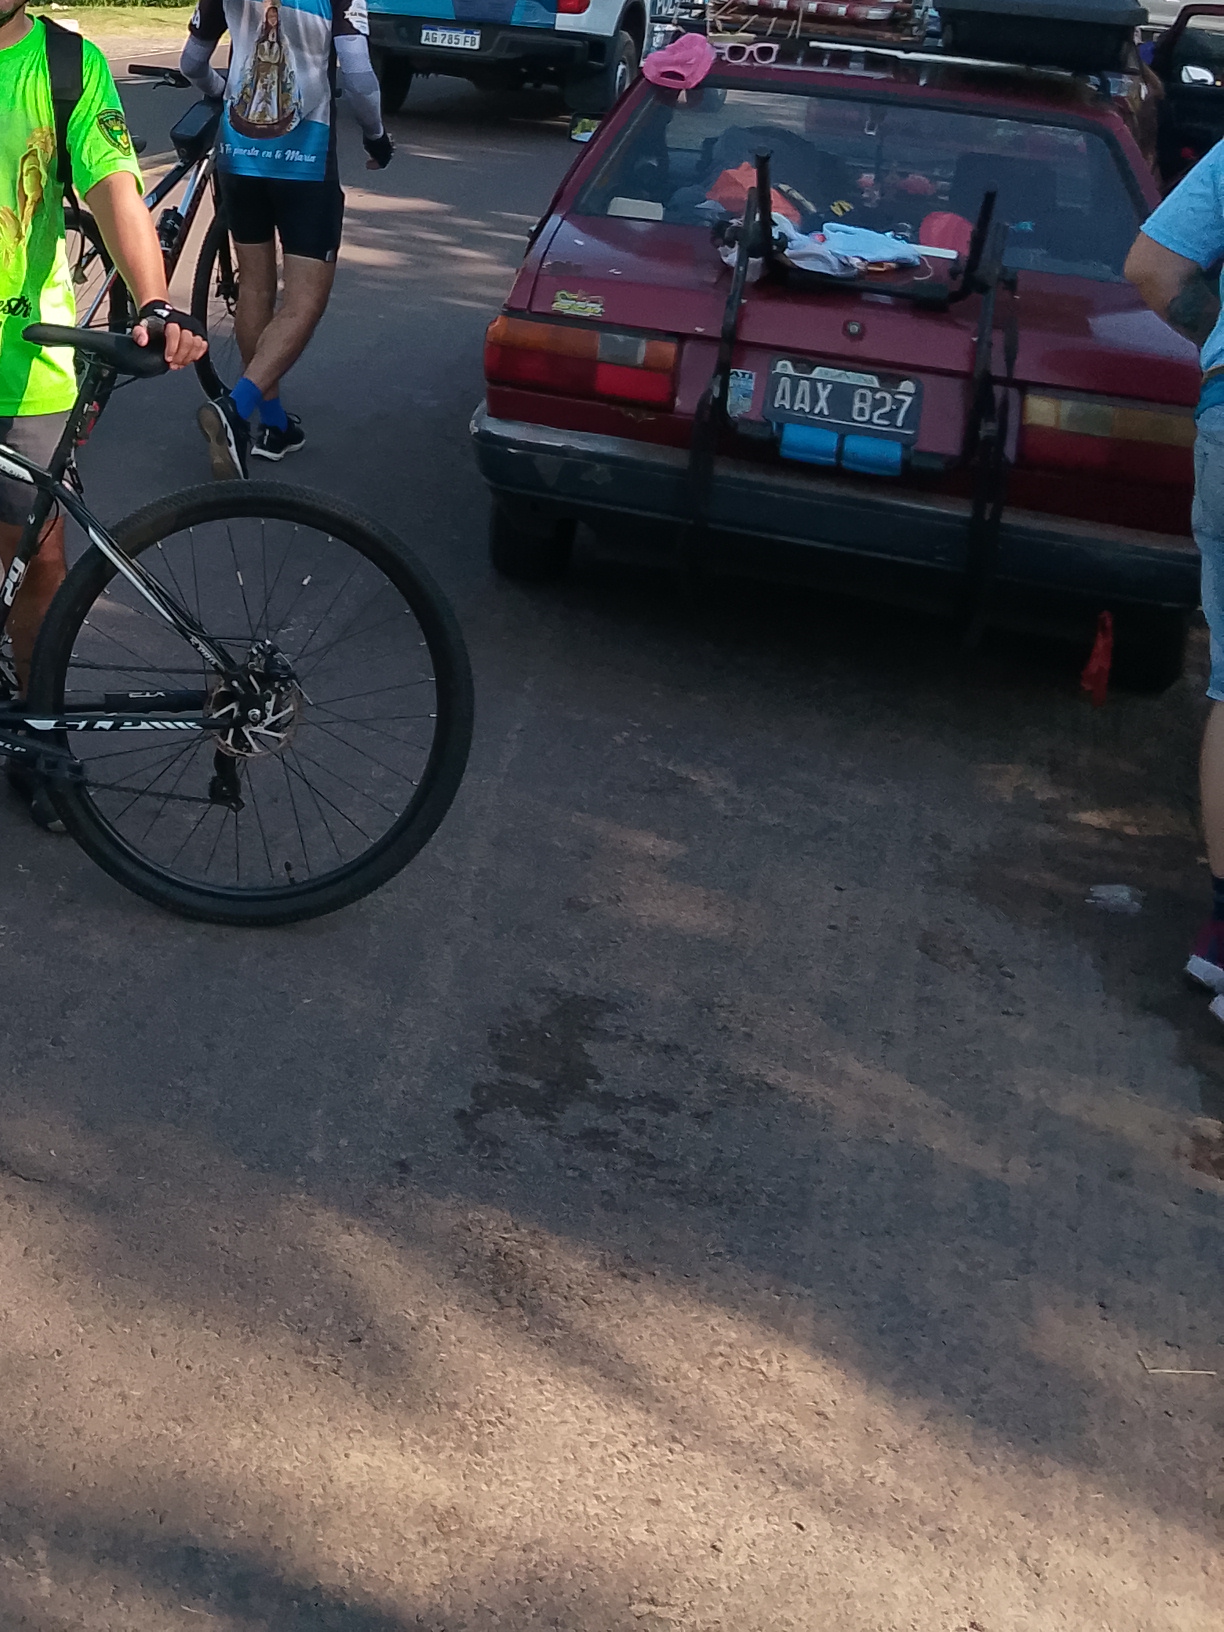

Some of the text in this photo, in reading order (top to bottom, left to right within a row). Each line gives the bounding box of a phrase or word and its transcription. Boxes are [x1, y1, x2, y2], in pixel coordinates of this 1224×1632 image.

[440, 33, 461, 46] 785
[774, 376, 914, 428] AAX 827
